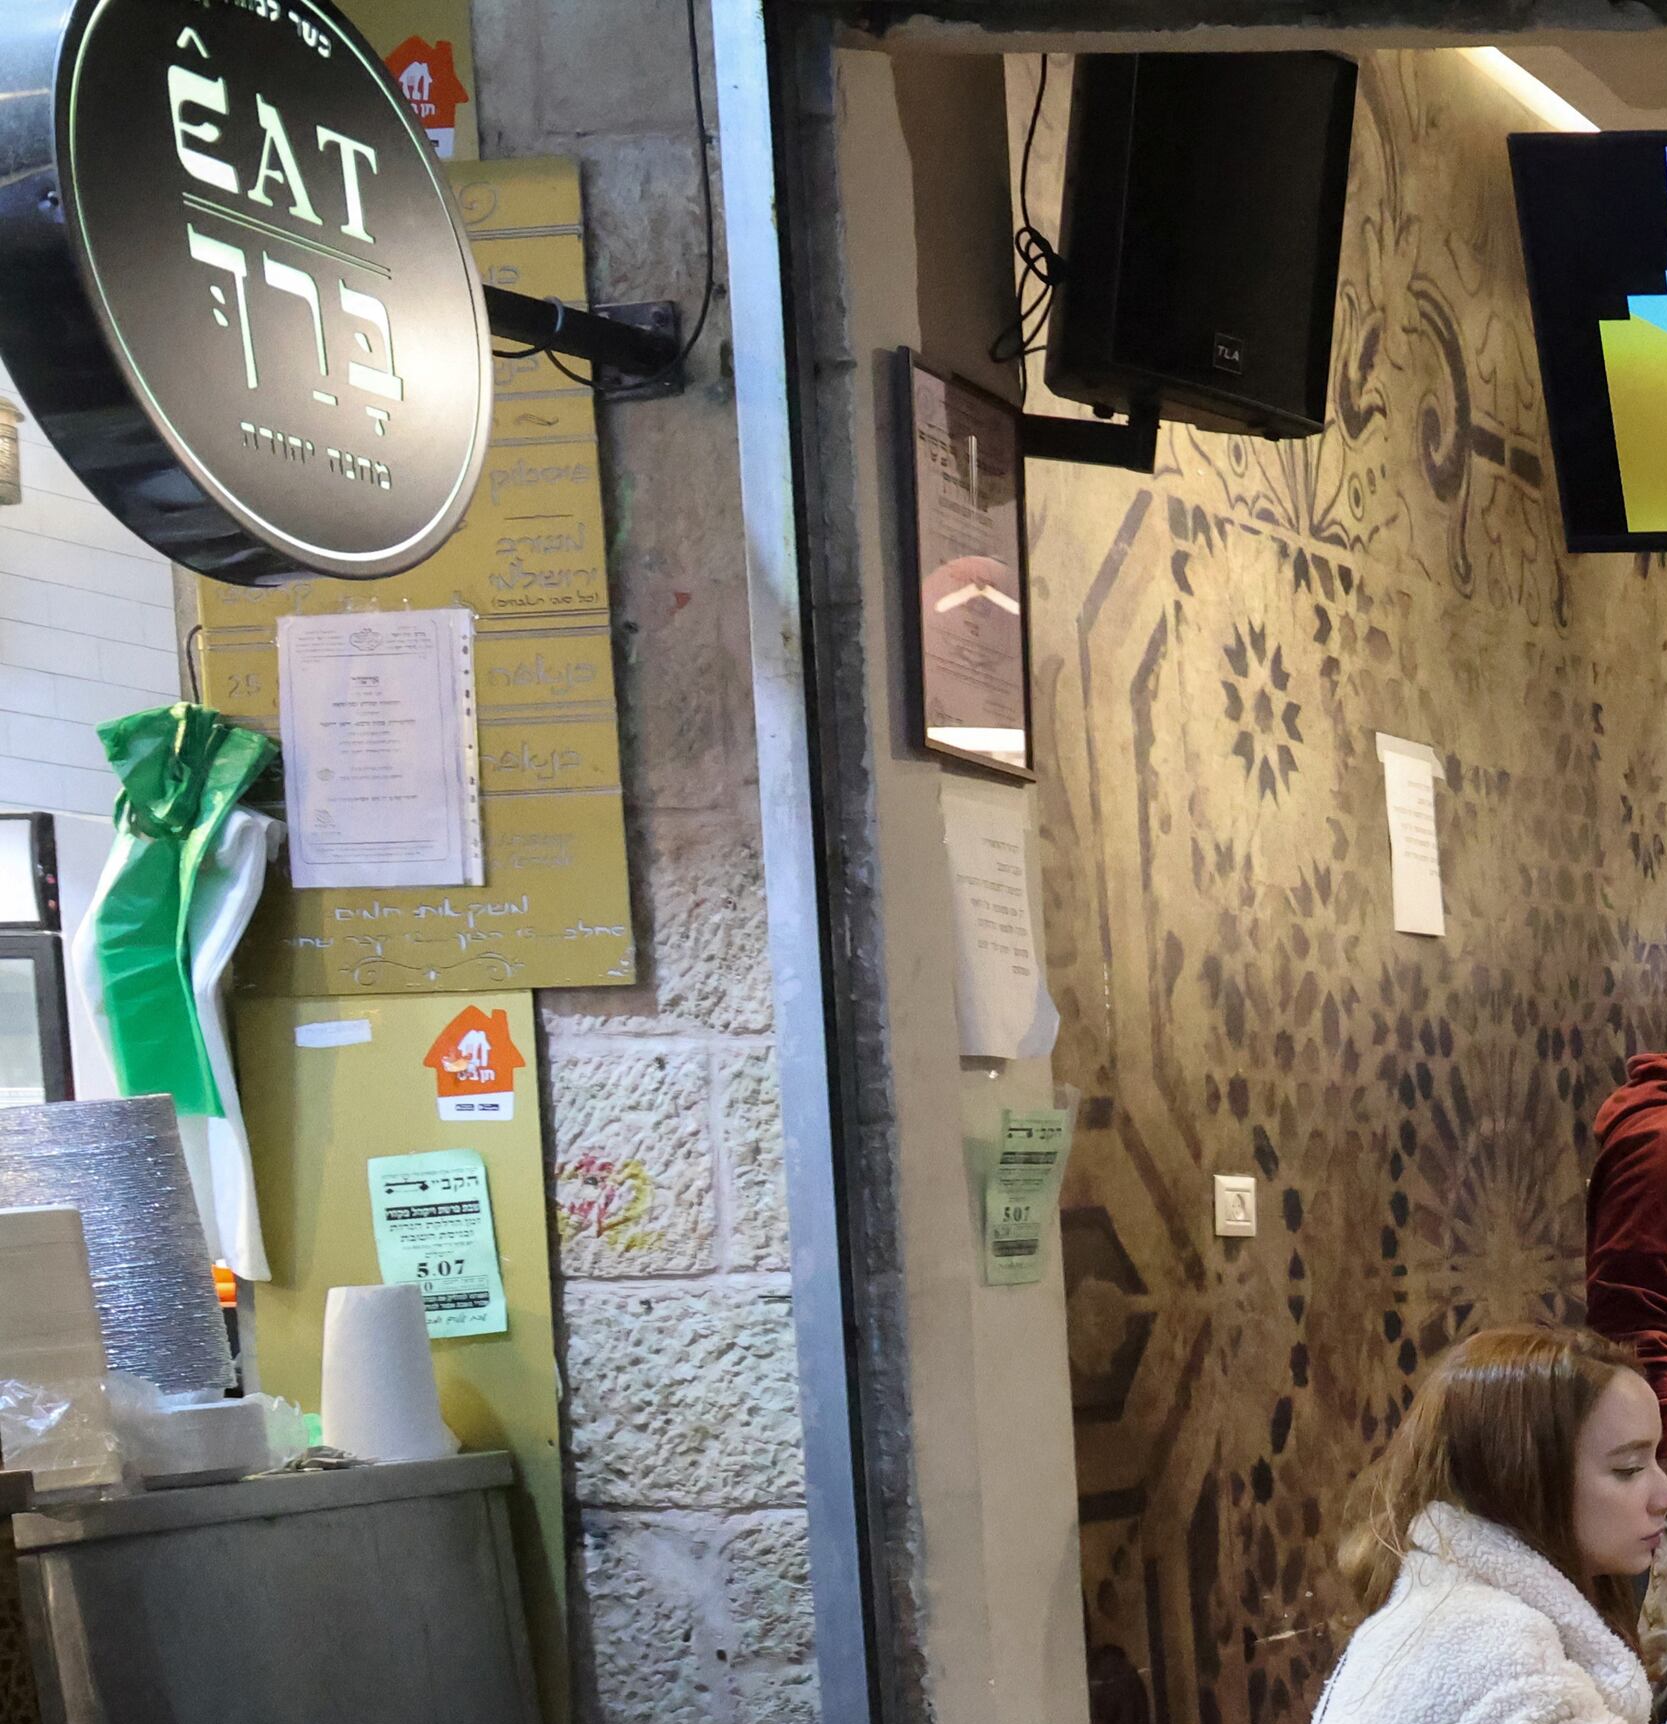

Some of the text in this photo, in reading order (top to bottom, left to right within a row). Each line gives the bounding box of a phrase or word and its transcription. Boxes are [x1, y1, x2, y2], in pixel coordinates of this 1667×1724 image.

[240, 421, 392, 490] מחנה יהודה
[417, 1259, 465, 1278] 5.07
